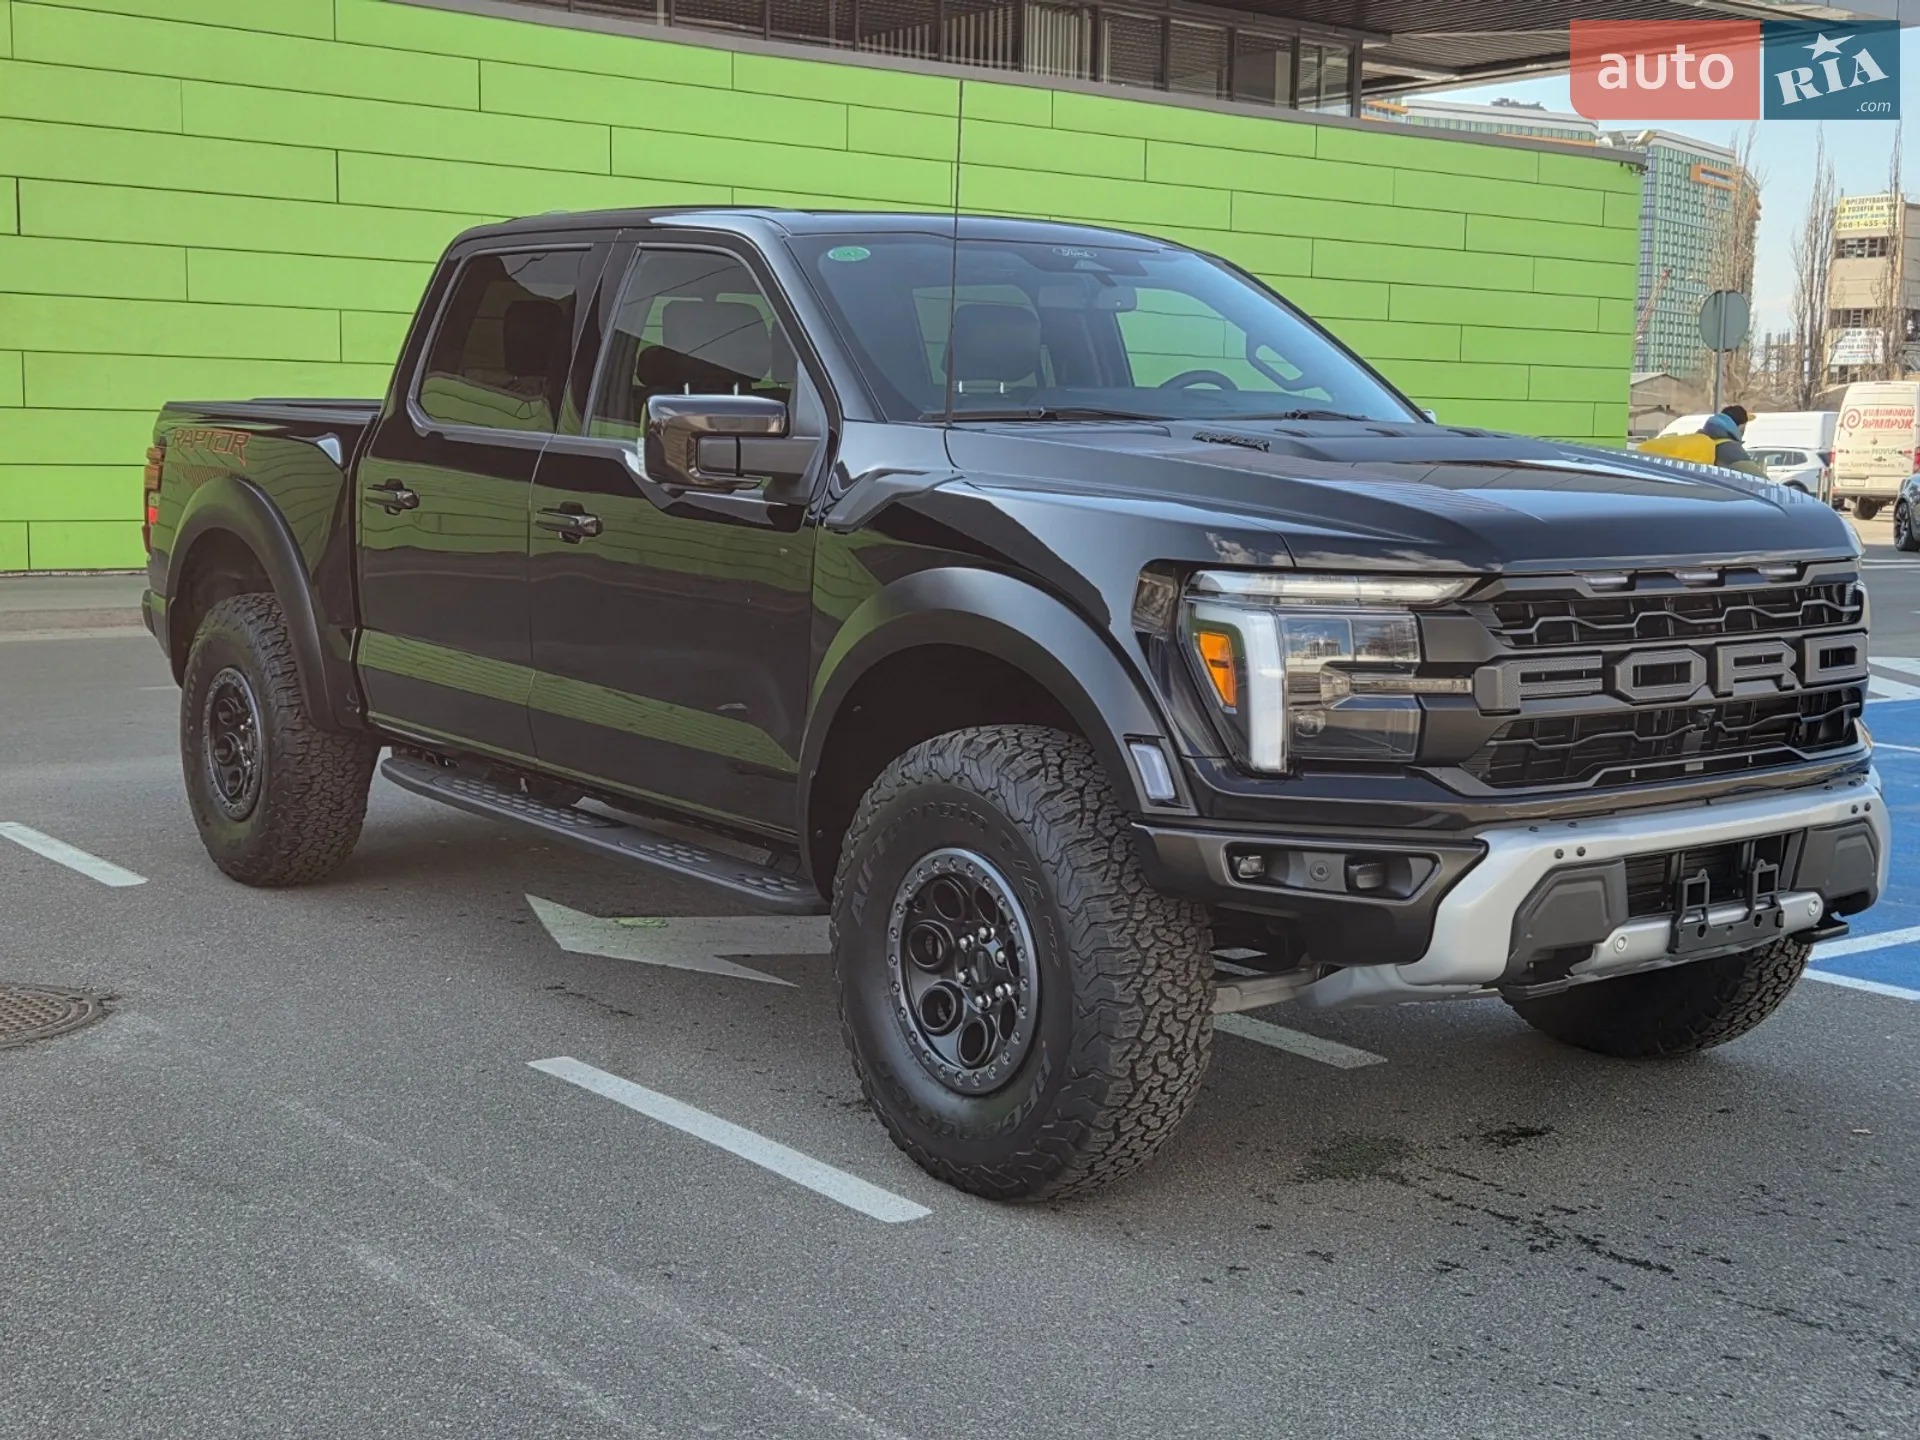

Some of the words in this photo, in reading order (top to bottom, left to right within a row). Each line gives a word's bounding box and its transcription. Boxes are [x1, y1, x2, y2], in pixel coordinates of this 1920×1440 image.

[171, 428, 251, 467] RAPTOR
[1872, 447, 1897, 455] NOVUS
[1482, 632, 1868, 715] FORD
